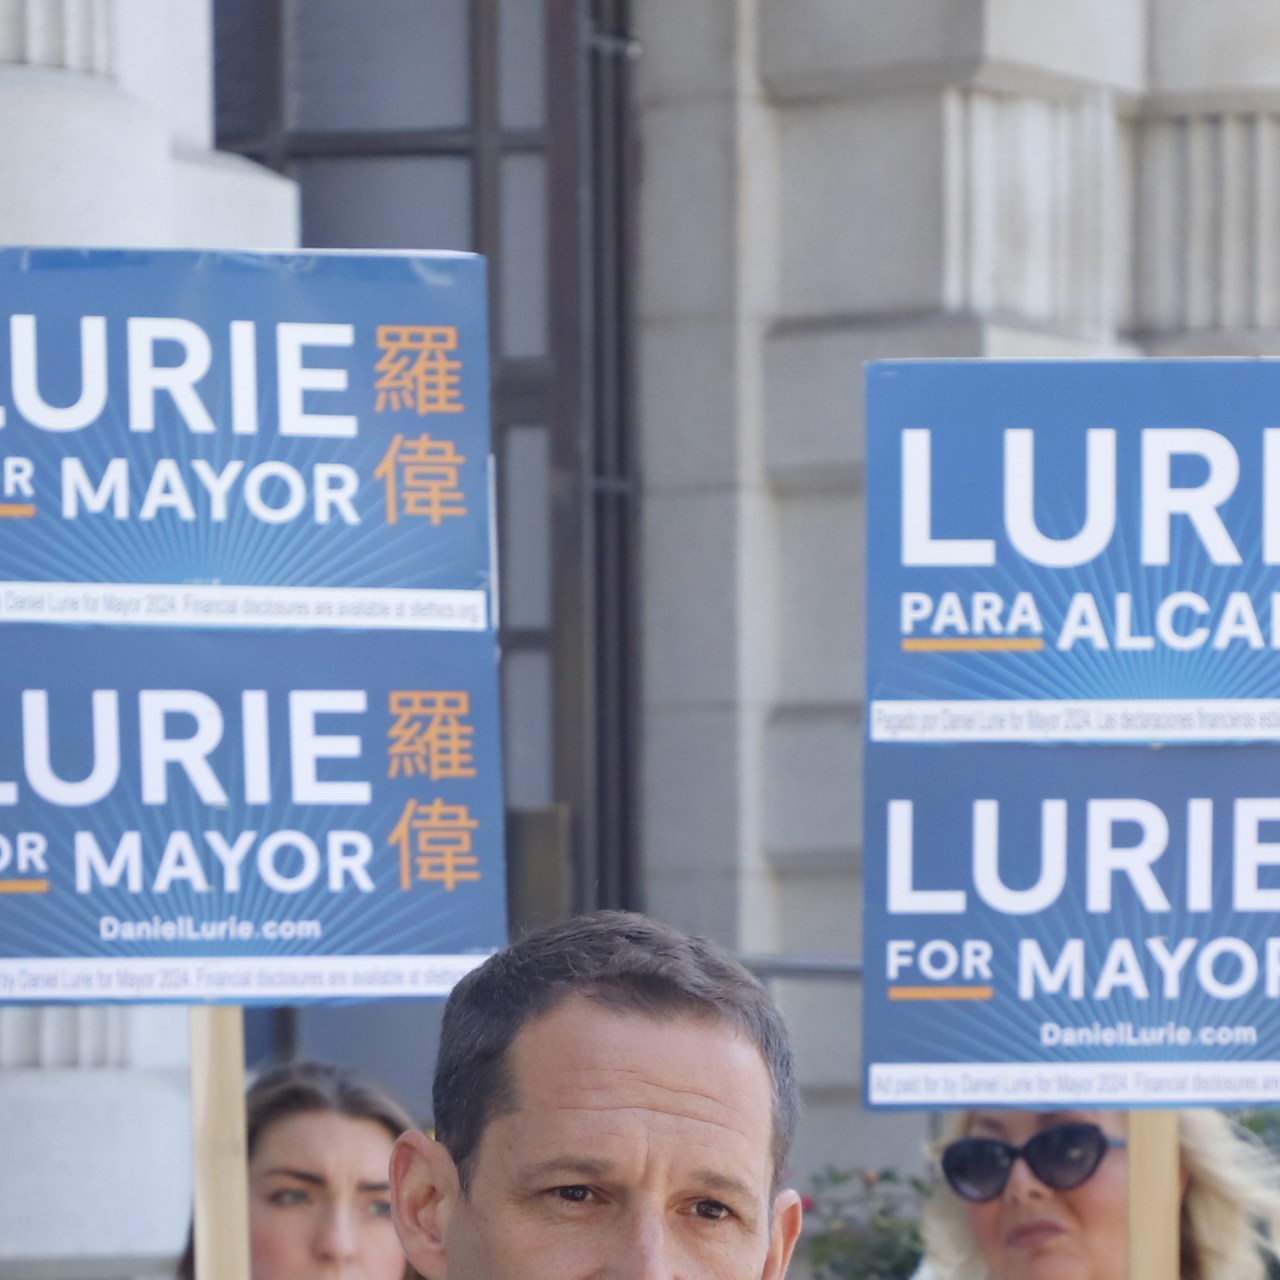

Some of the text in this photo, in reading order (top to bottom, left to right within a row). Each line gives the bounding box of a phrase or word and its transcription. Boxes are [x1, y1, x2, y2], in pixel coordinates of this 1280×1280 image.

[62, 458, 360, 525] MAYOR
[902, 592, 1043, 633] PARA
[75, 830, 374, 892] MAYOR
[98, 914, 323, 942] DanielLurie.com
[888, 940, 992, 979] FOR
[1039, 1021, 1259, 1048] DanielLurie.com
